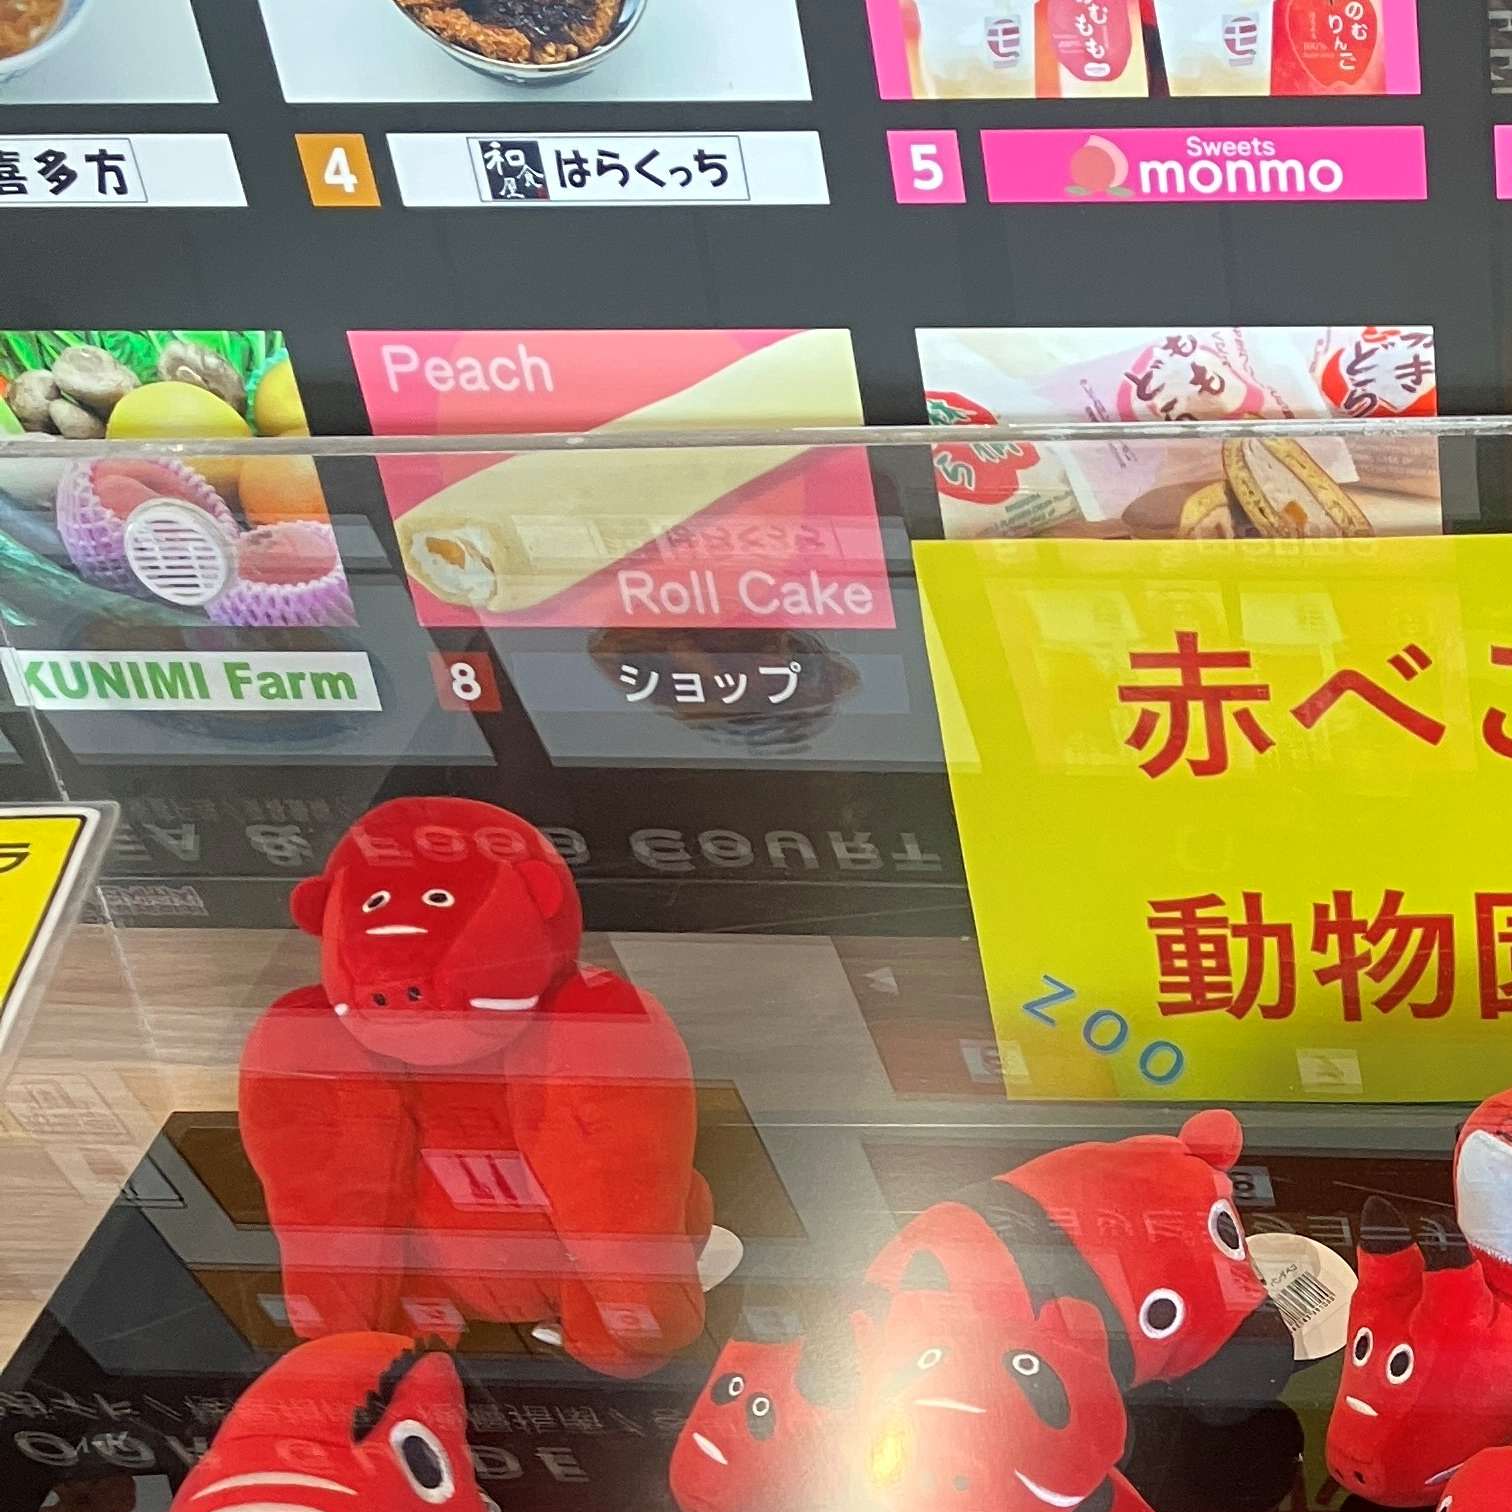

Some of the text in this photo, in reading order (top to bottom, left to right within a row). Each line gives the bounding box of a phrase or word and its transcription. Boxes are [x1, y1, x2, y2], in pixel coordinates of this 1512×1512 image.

[1327, 14, 1357, 70] りんご
[1344, 1, 1368, 41] のむ
[323, 146, 358, 193] 4
[554, 148, 729, 188] はらくっち
[910, 144, 944, 190] 5
[1186, 136, 1276, 158] Sweets
[0, 148, 129, 196] 喜多方
[1139, 158, 1344, 194] monmo
[379, 343, 555, 393] Peach
[616, 569, 874, 615] Roll Cake
[24, 661, 358, 700] KUNIMI Farm
[450, 657, 482, 701] 8
[618, 661, 802, 704] ショップ
[1021, 974, 1186, 1086] ZOO
